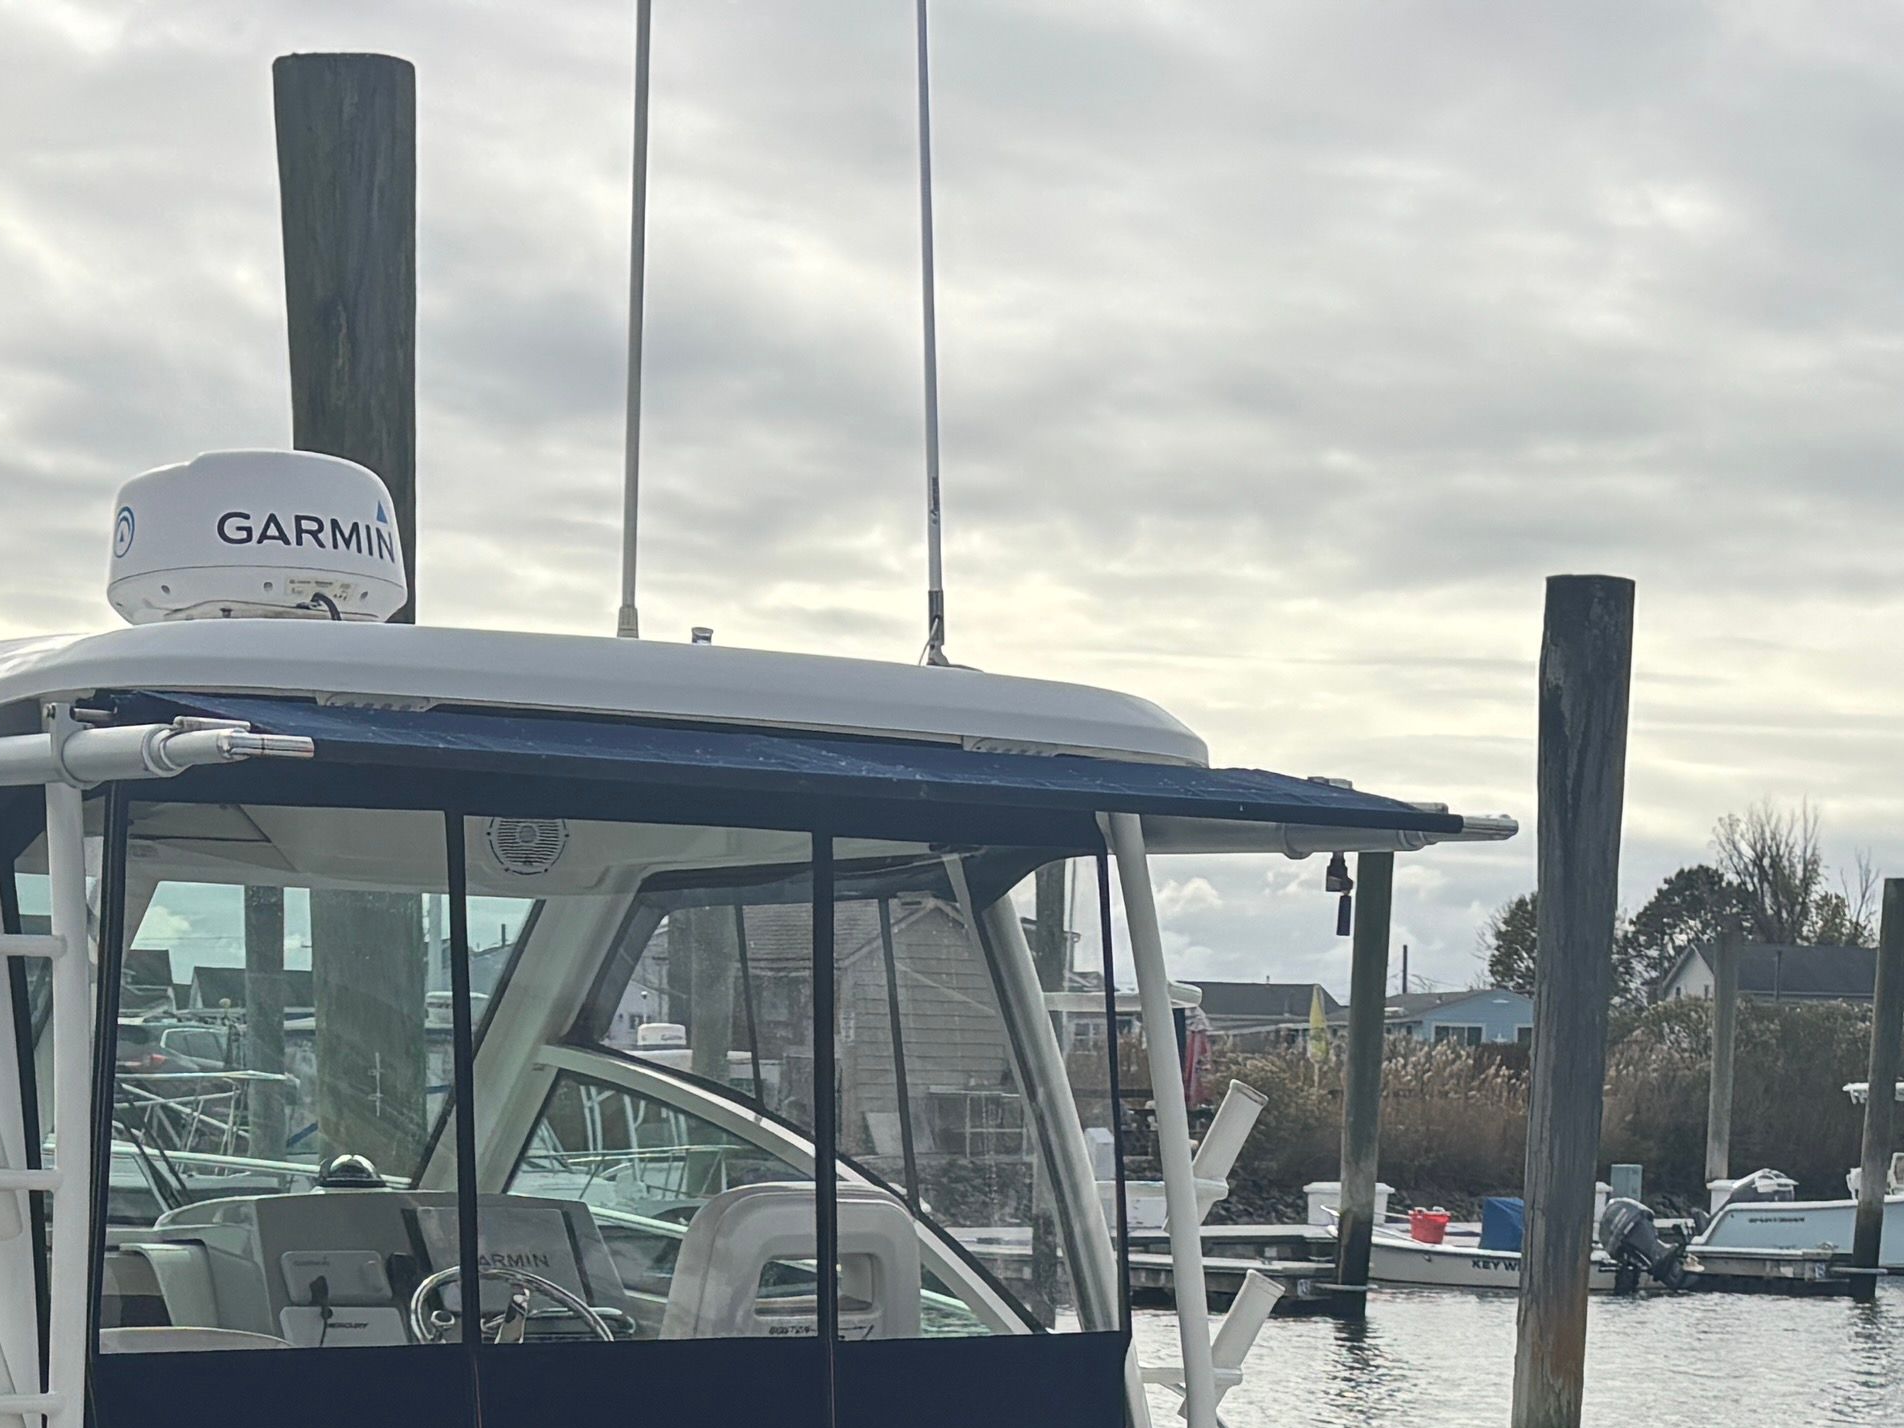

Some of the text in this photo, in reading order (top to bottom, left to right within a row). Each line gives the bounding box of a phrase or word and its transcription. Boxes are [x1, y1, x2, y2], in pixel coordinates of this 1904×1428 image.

[216, 510, 396, 564] GARMIN
[478, 1252, 551, 1269] ARMIN
[1471, 1259, 1499, 1271] KEY
